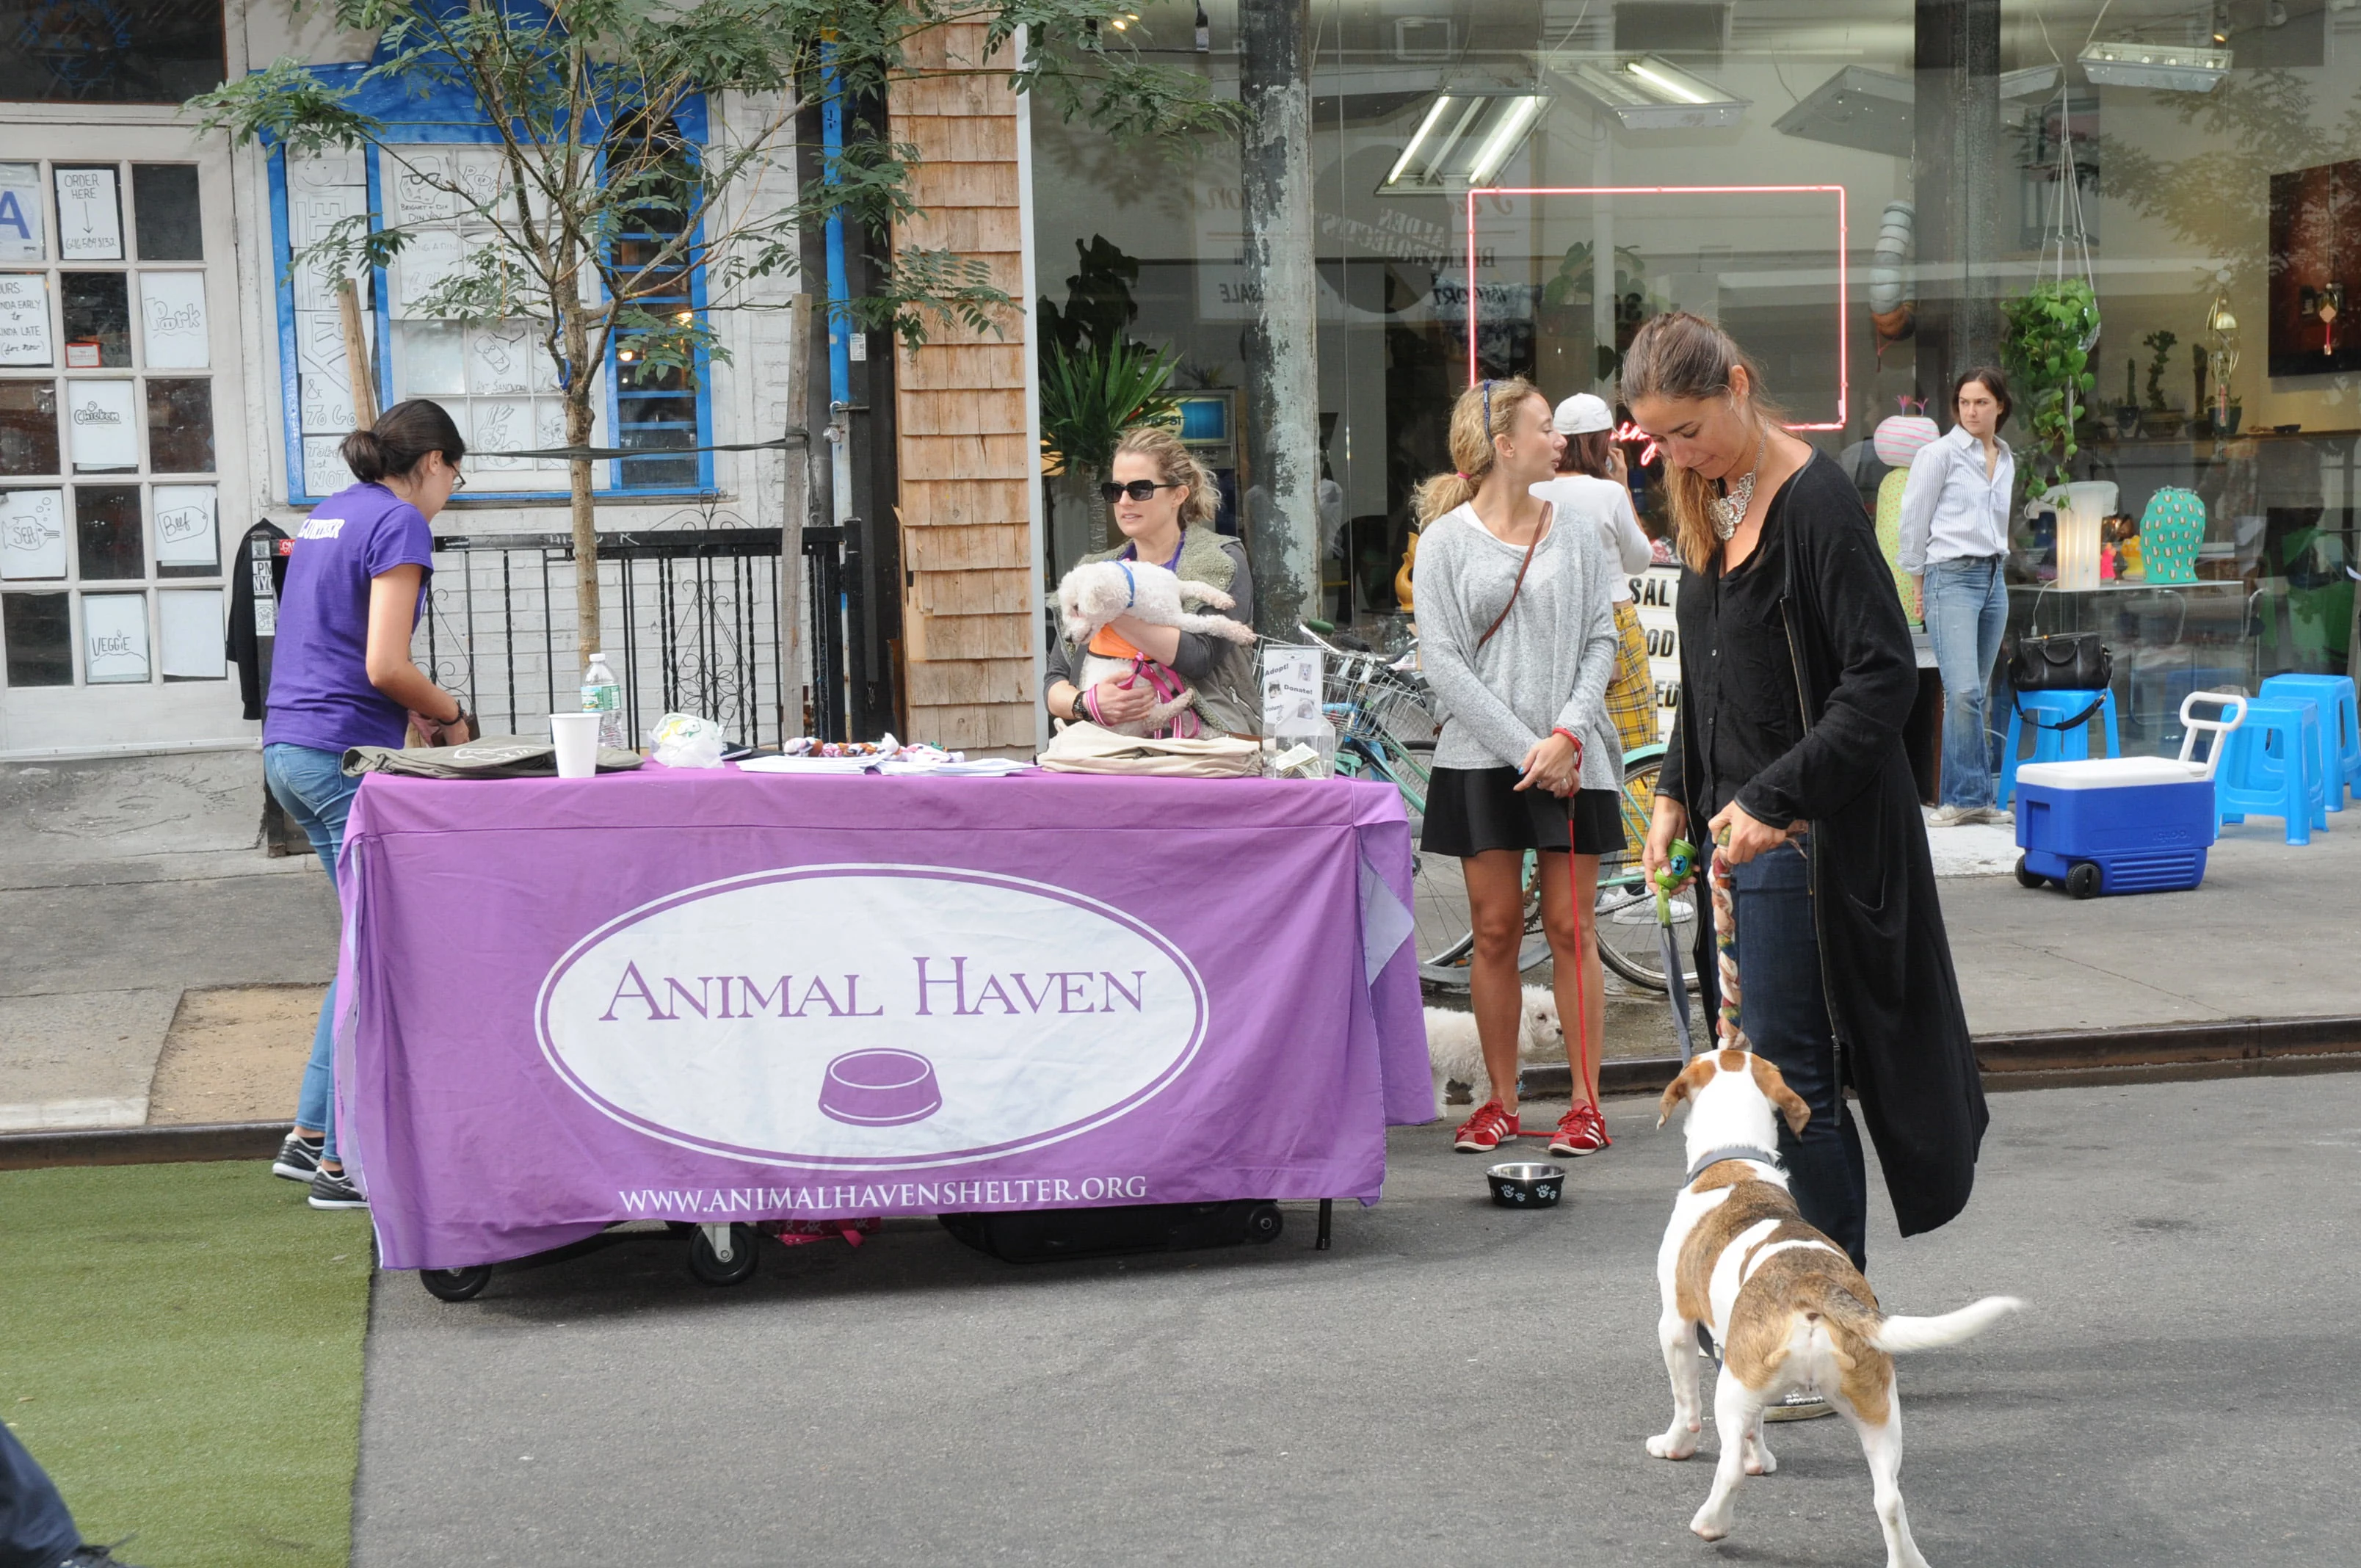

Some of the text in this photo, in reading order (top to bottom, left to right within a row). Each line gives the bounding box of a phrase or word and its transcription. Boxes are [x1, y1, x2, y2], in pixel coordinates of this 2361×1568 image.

[65, 173, 100, 187] ORDER
[71, 187, 97, 199] HERE
[0, 191, 32, 240] A
[18, 300, 41, 310] EARLY
[21, 326, 41, 336] LATE
[74, 407, 120, 425] Chicken
[163, 512, 191, 537] Beef
[1628, 577, 1680, 607] SAL
[1265, 663, 1289, 677] Adopt!
[1283, 684, 1313, 695] Donate!
[598, 956, 1147, 1022] ANIMAL HAVEN
[618, 1175, 1147, 1213] WWW.ANIMALHAVENSHELTER.ORG
